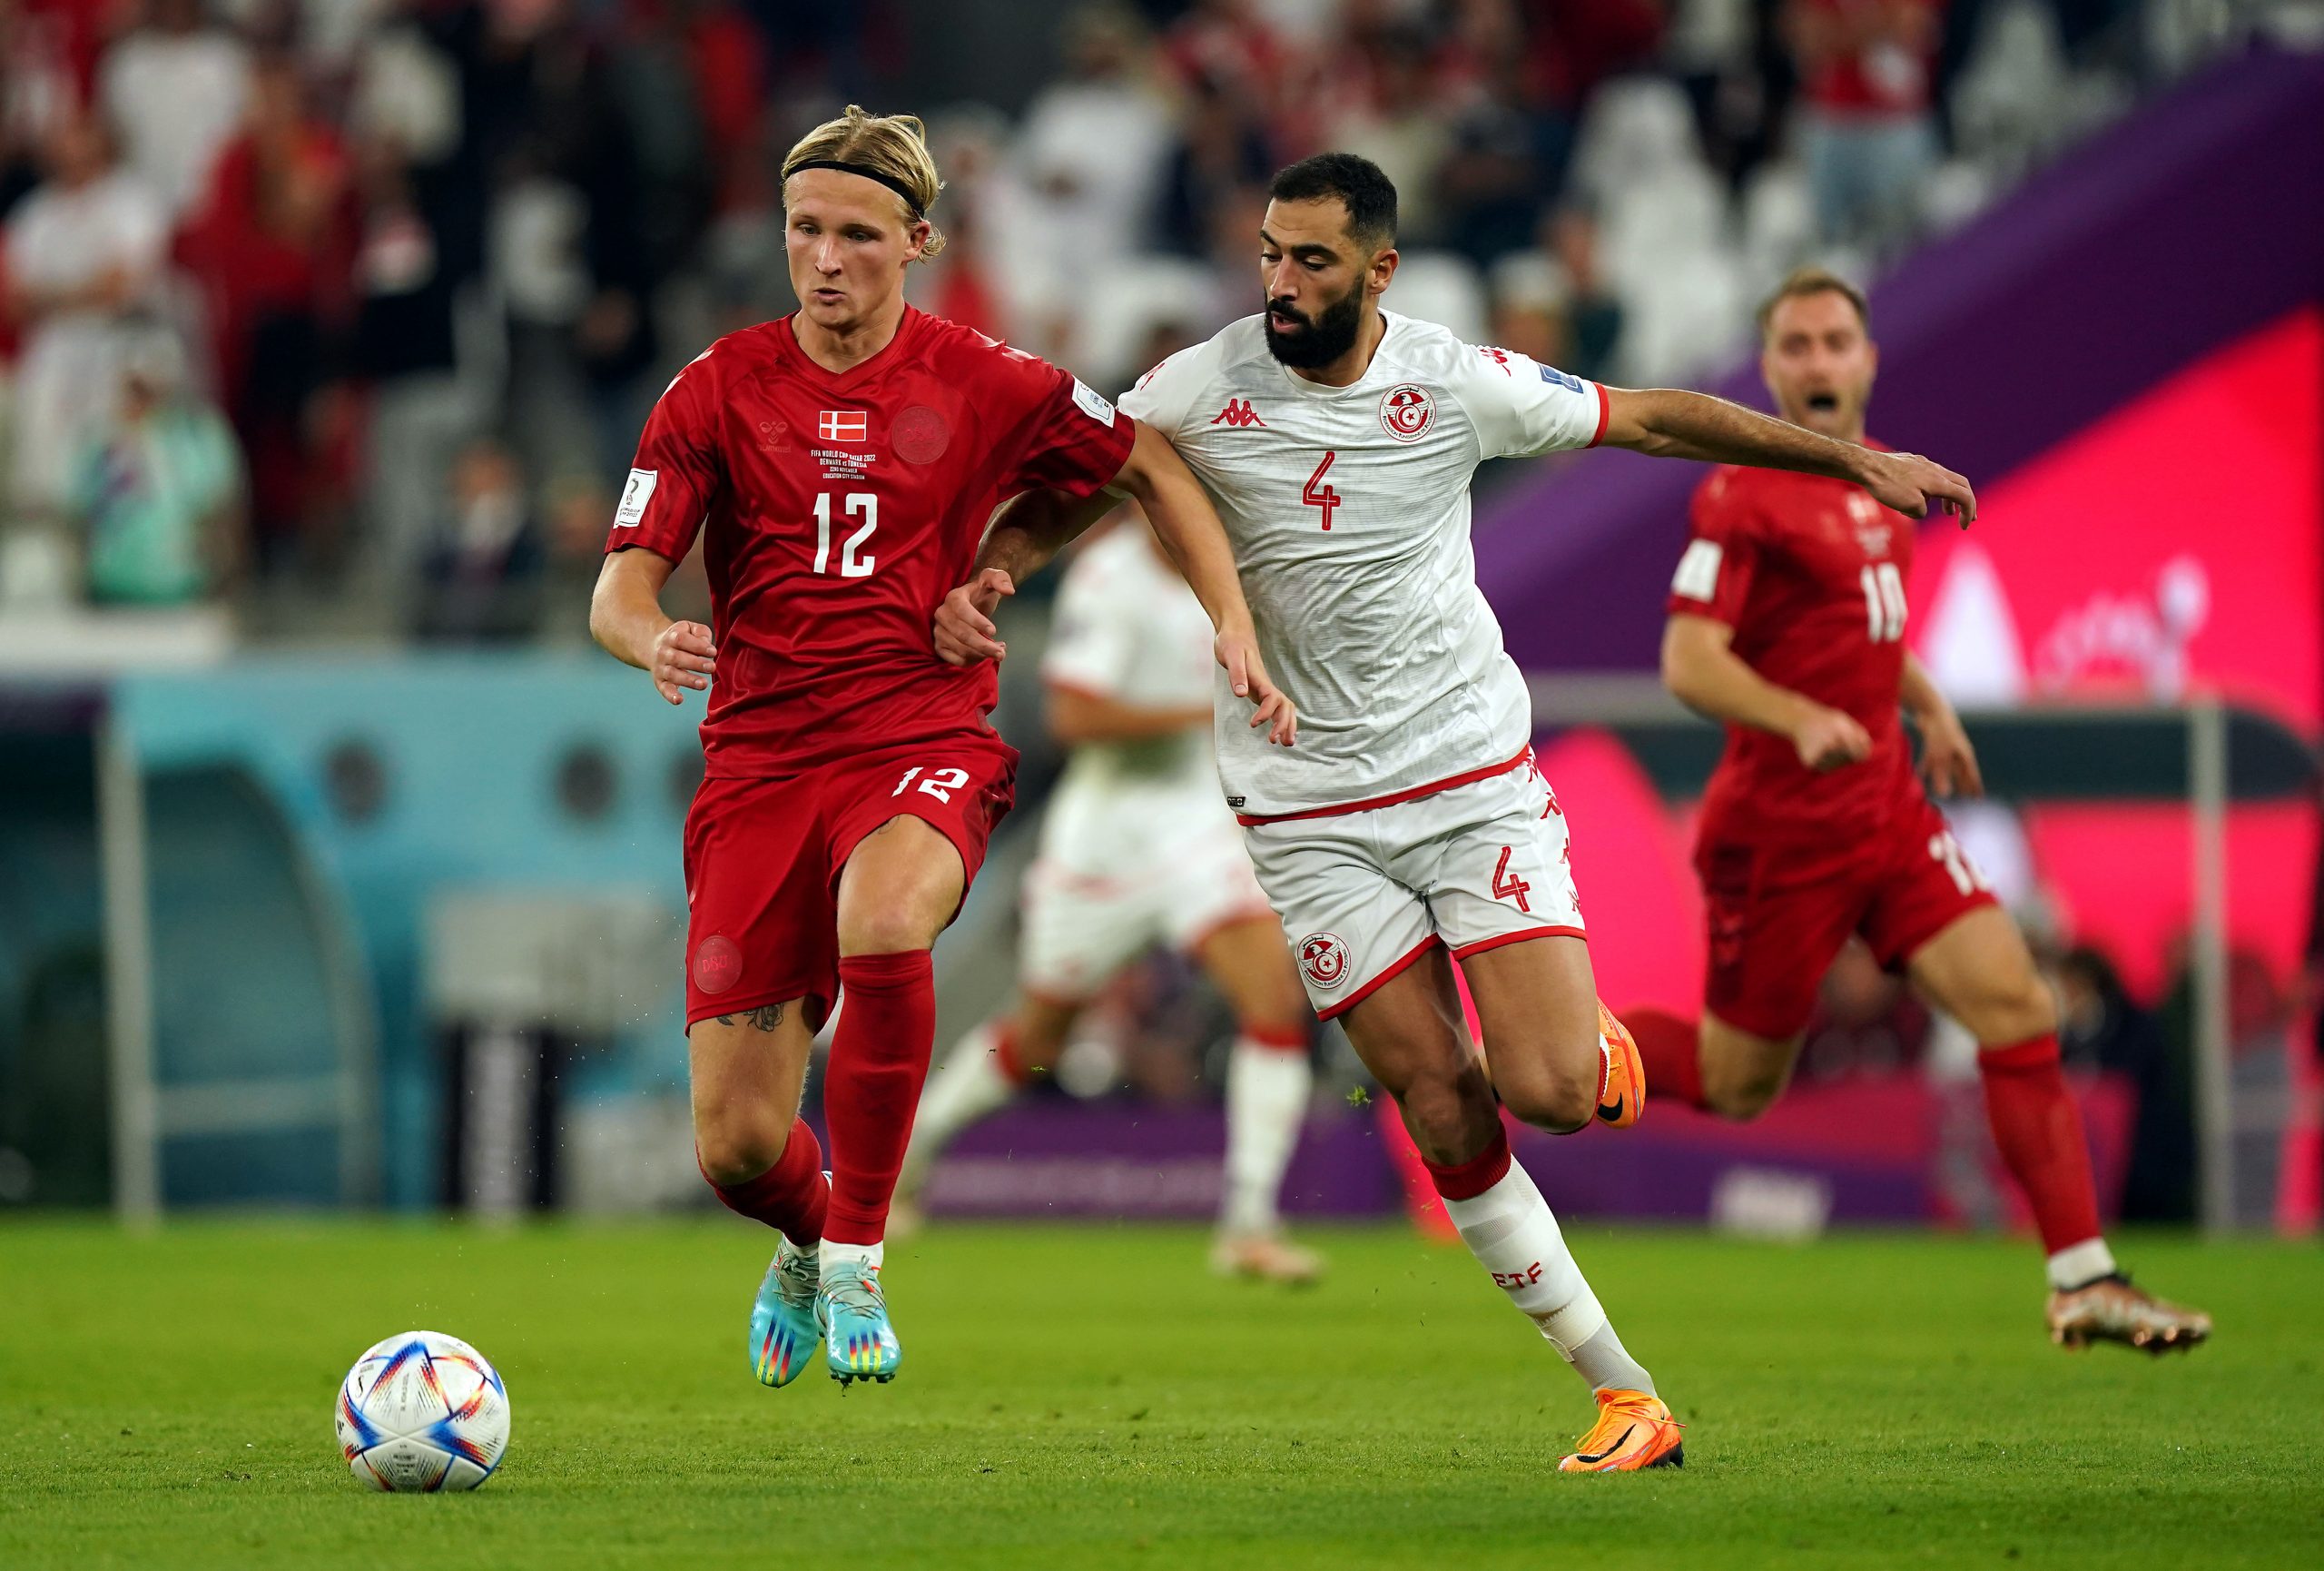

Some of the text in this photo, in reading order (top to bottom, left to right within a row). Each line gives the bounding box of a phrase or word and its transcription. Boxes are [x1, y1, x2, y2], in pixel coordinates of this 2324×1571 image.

[819, 458, 842, 466] DENMARK
[822, 450, 838, 458] WORLD
[1303, 450, 1341, 531] 4
[812, 492, 878, 578] 12
[1860, 562, 1908, 644] 10
[891, 766, 970, 805] 12
[1492, 845, 1531, 913] 4
